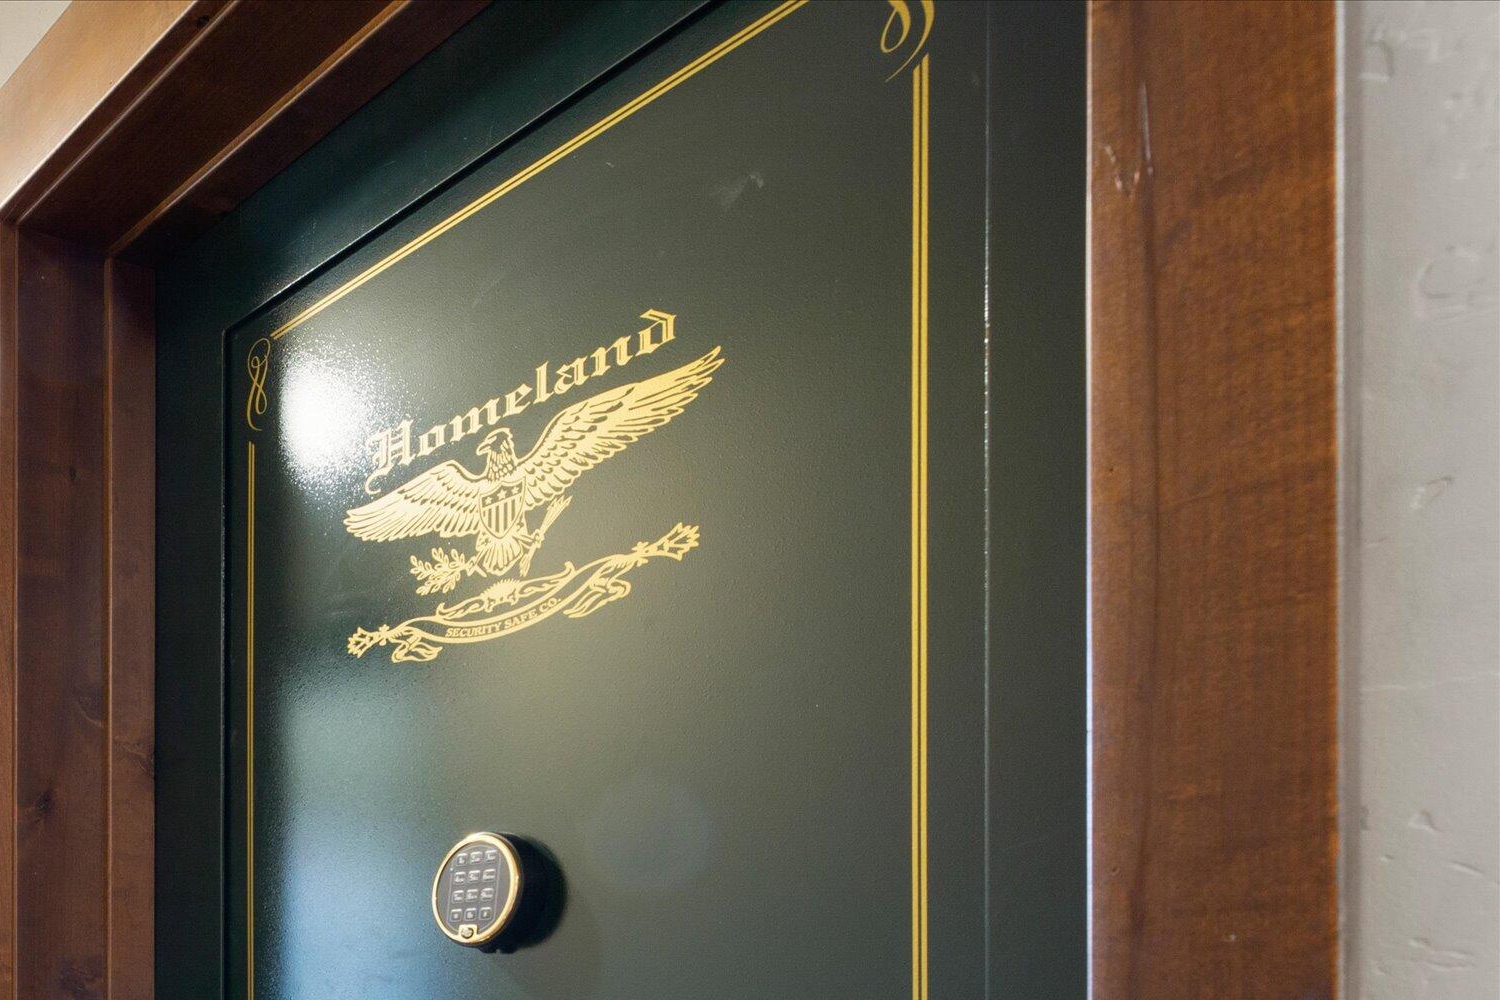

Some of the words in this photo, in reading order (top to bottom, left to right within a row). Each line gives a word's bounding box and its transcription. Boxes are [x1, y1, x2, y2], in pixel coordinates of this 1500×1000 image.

[364, 308, 677, 495] Homeland
[445, 623, 502, 637] SECURITY
[504, 609, 539, 628] SAFE
[539, 597, 561, 612] CO.
